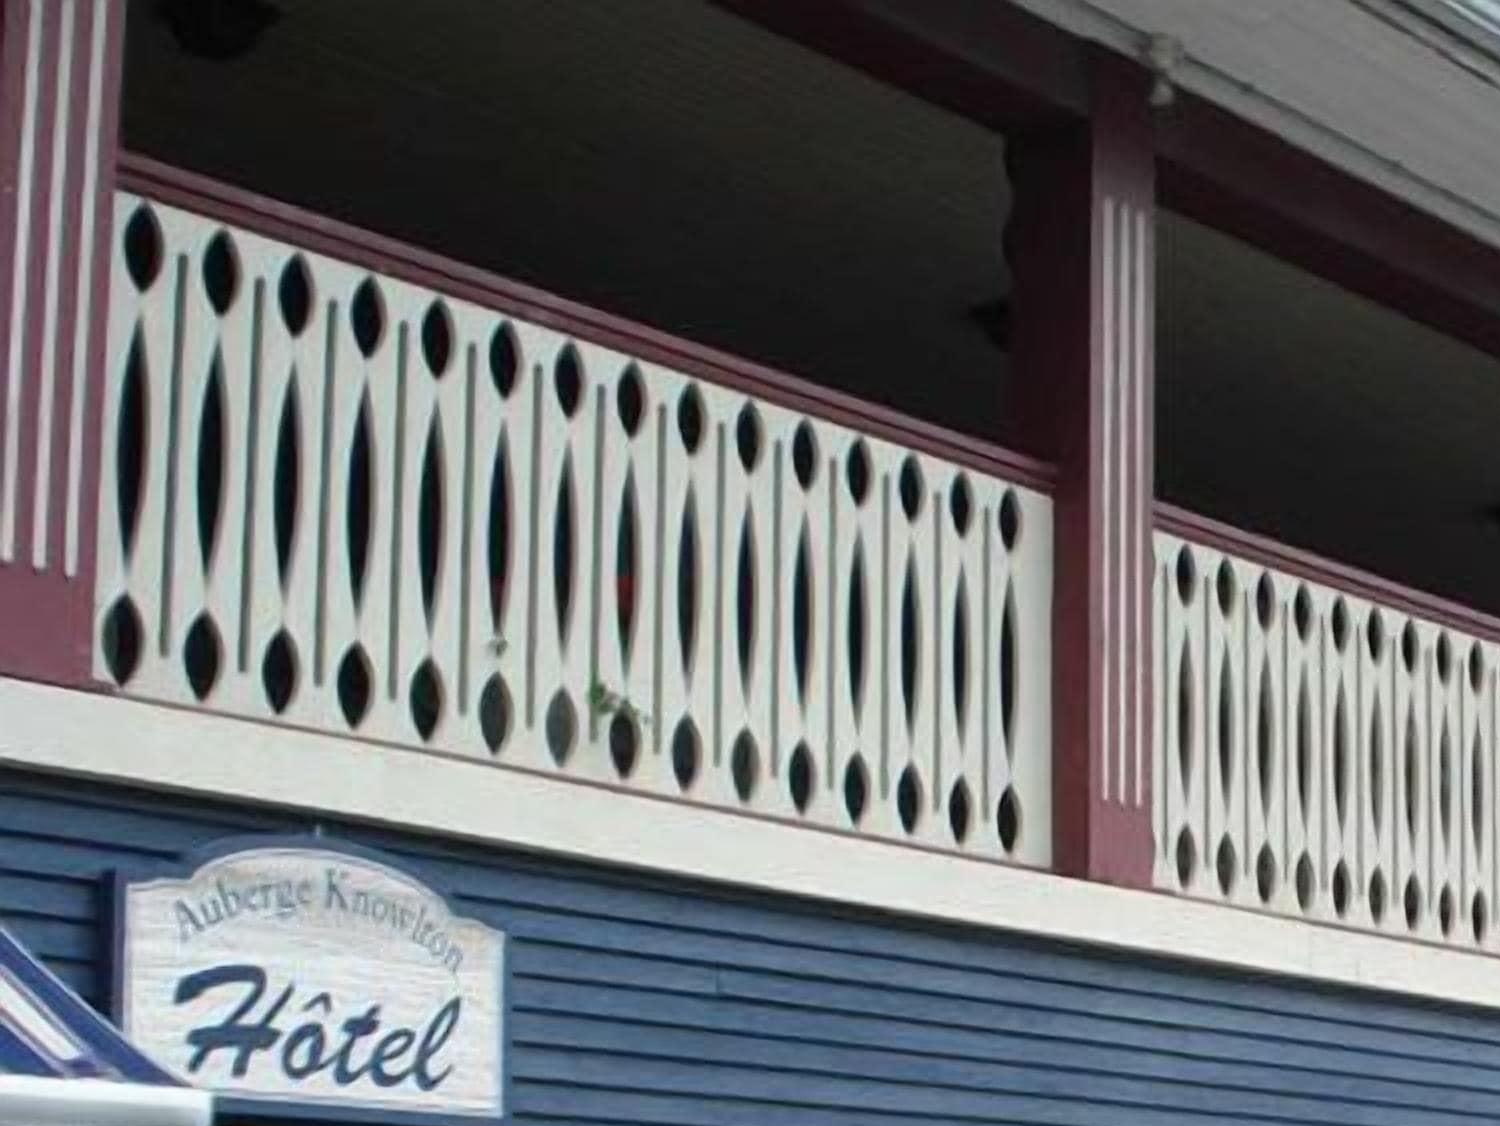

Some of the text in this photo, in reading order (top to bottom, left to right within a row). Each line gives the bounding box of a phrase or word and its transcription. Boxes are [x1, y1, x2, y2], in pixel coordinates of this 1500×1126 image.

[173, 866, 465, 974] Auberge Knowlton
[174, 964, 461, 1092] Hôtel
